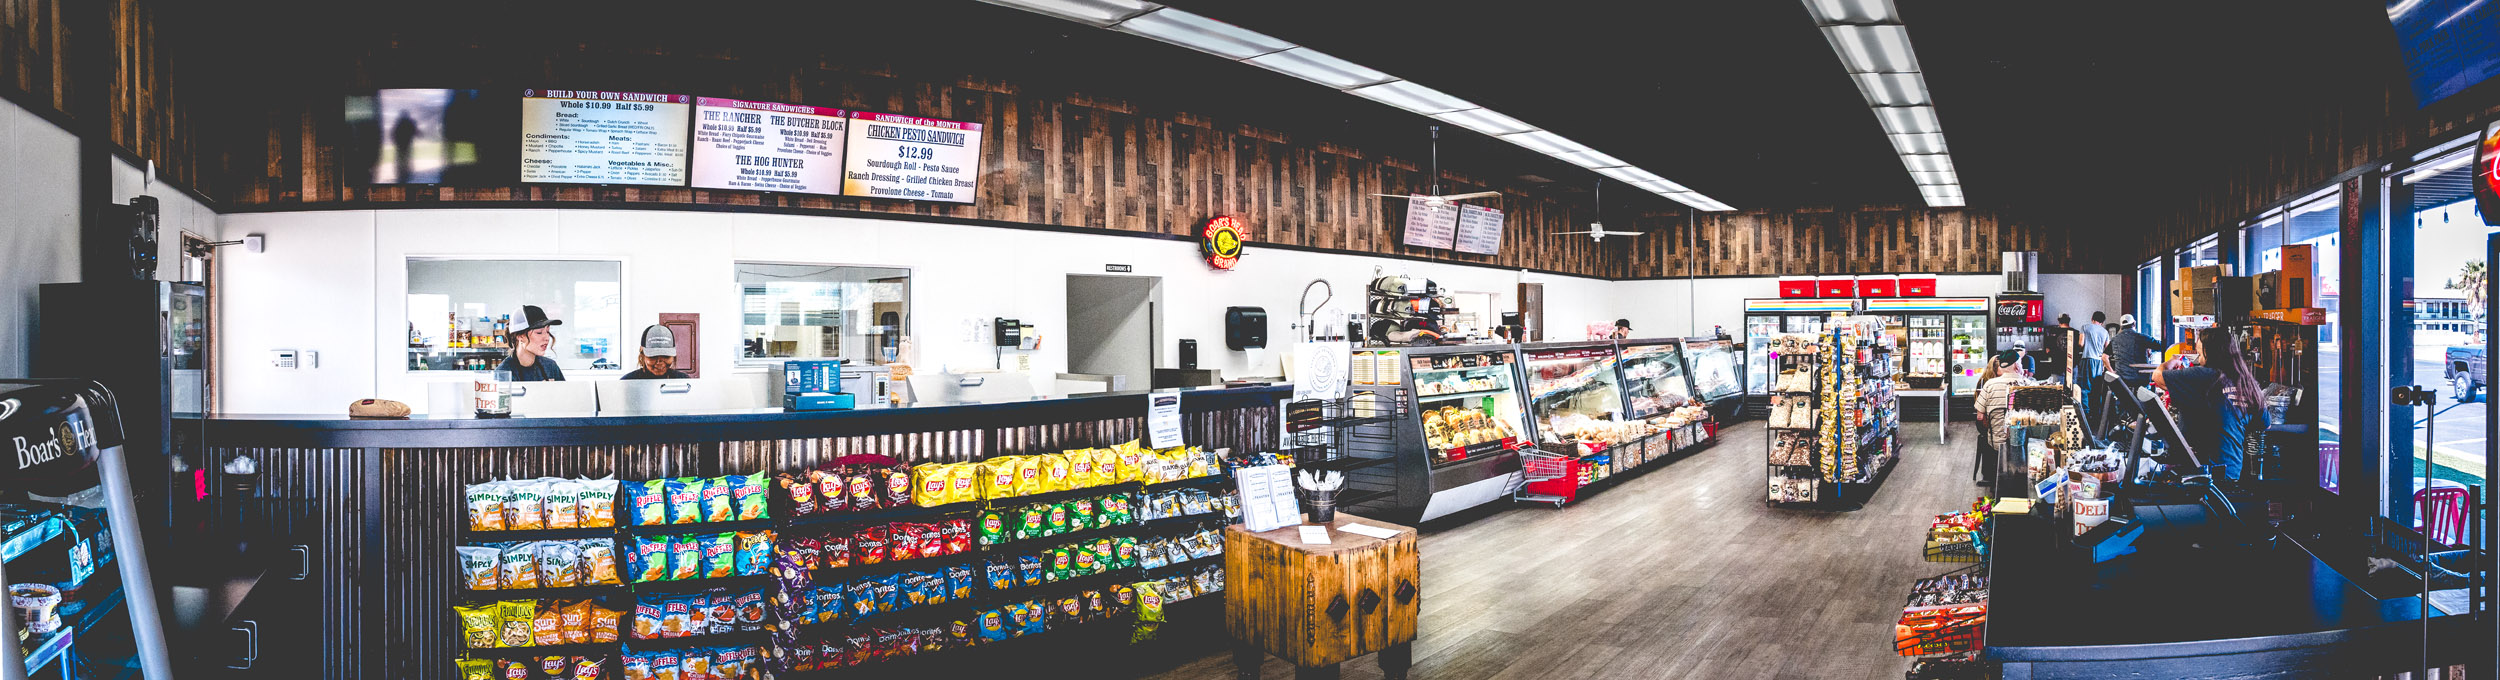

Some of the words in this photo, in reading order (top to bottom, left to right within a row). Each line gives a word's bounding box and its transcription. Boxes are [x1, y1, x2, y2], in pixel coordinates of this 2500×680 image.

[547, 90, 574, 99] BUILD
[576, 91, 598, 99] YOUR
[600, 92, 621, 101] OWN
[622, 92, 668, 102] SANDWICH
[560, 101, 584, 109] Whole
[586, 101, 611, 110] $10.99
[616, 103, 631, 111] Half
[633, 104, 654, 112] $5.99
[732, 101, 771, 111] SIGNATURE
[772, 104, 815, 114] SANDWICHES
[703, 110, 721, 121] THE
[723, 112, 762, 124] RANCHER
[770, 115, 786, 126] THE
[787, 117, 820, 129] BUTCHER
[822, 120, 844, 131] BLOCK
[875, 114, 914, 125] SANDWICH
[924, 119, 934, 127] the
[936, 121, 961, 130] MONTH
[718, 124, 735, 132] $10.99
[868, 124, 900, 139] CHICKEN
[902, 127, 926, 142] PESTO
[927, 130, 965, 145] SANDWICH
[898, 145, 933, 160] $12.99
[736, 155, 752, 165] THE
[754, 156, 770, 166] HOG
[772, 157, 804, 169] HUNTER
[867, 159, 902, 171] Sourdough
[904, 162, 917, 171] Roll
[923, 163, 940, 172] Pesto
[941, 165, 960, 174] Sauce
[848, 171, 870, 181] Ranch
[871, 172, 900, 184] Dressing
[906, 175, 927, 185] Grilled
[929, 176, 953, 186] Chicken
[954, 178, 974, 188] Breast
[870, 186, 902, 196] Provolone
[903, 188, 925, 197] Cheese
[931, 190, 954, 198] Tomato
[1206, 217, 1230, 238] BOAR'S
[1231, 218, 1246, 241] HEAD
[1214, 257, 1238, 269] BRAND
[474, 381, 497, 392] DELI
[475, 397, 497, 409] TIPS
[13, 427, 62, 470] Boar's
[469, 493, 502, 503] SIMPLY
[512, 492, 541, 502] SIMPLY
[580, 491, 614, 500] SIMPLY
[734, 485, 762, 499] RUFFLES
[547, 495, 576, 504] SIMPLY
[2075, 502, 2107, 516] DELI
[742, 532, 768, 551] Cheetos
[706, 544, 732, 557] RUFFLES
[503, 554, 532, 564] SIMPLY
[562, 614, 580, 625] Sun
[596, 617, 617, 628] Sun
